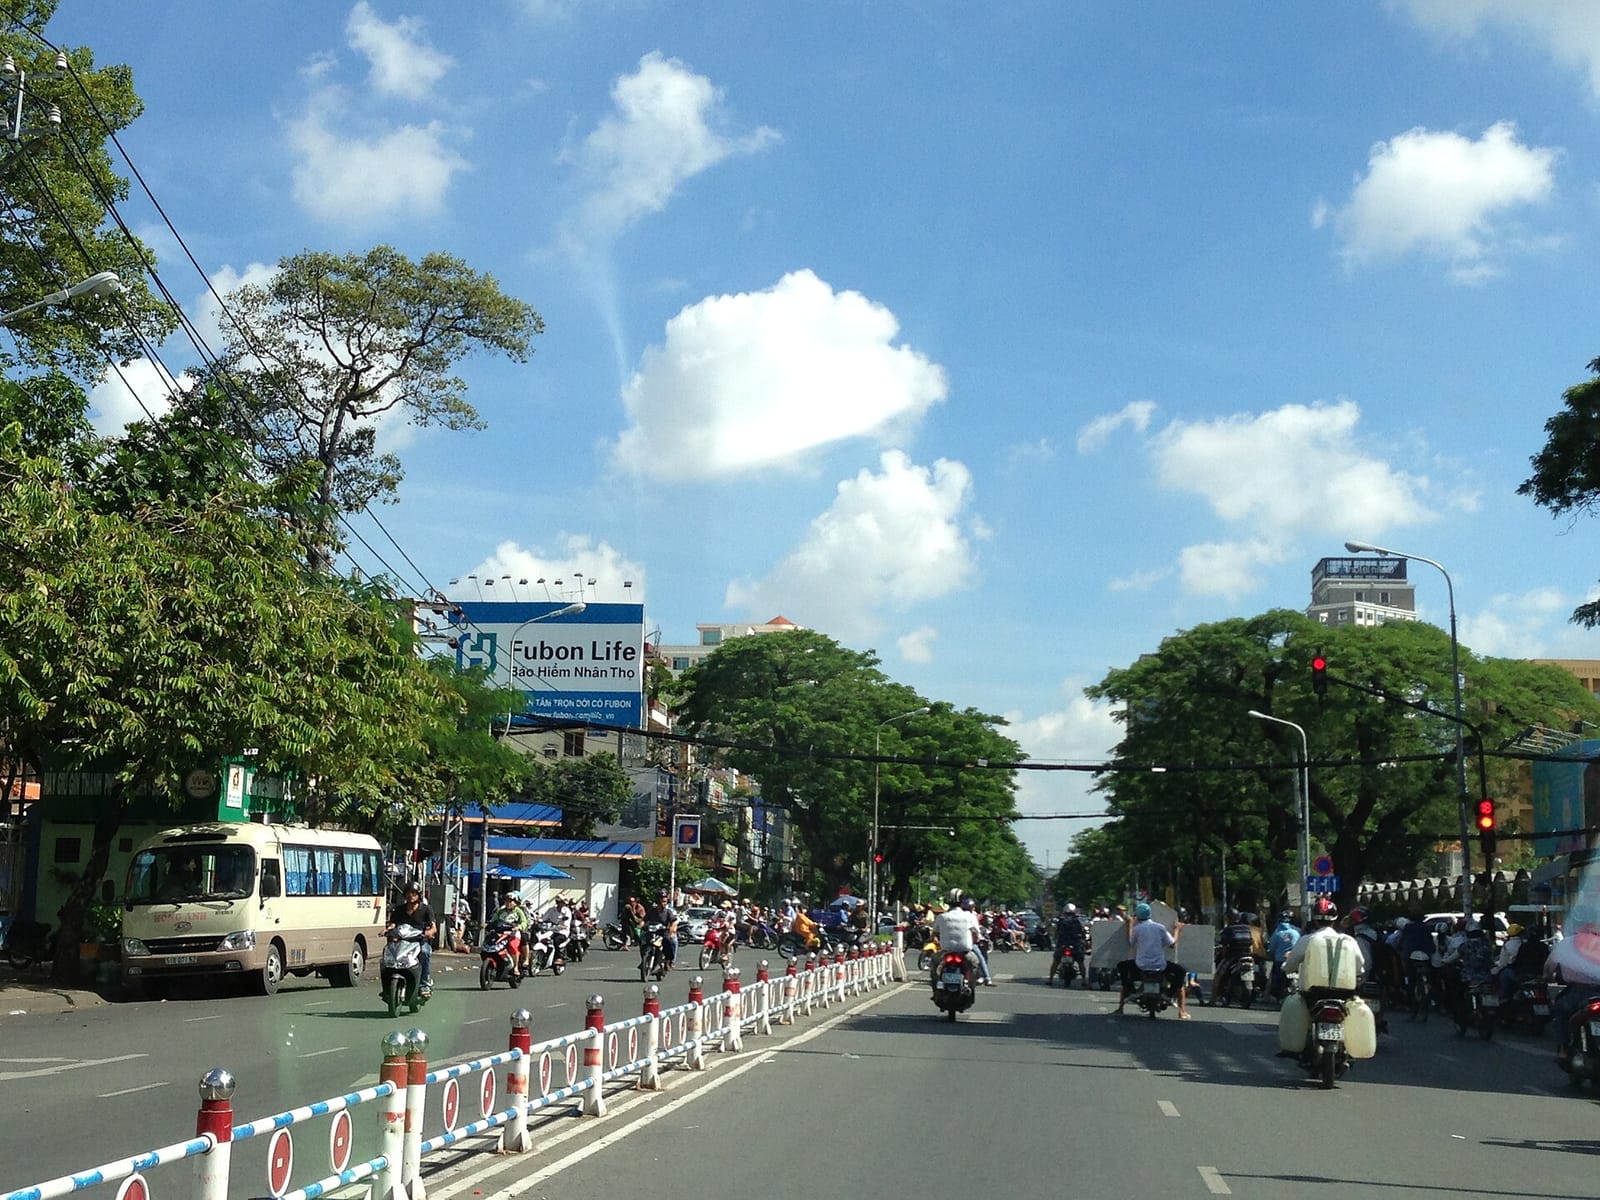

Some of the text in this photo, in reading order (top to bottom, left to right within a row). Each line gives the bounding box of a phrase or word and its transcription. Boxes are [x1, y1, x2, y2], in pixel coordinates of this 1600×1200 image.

[510, 640, 636, 661] Fubon Life
[538, 662, 571, 678] Hiểm
[574, 665, 608, 678] Nhân
[609, 666, 635, 681] Thọ
[604, 698, 632, 708] FUBON
